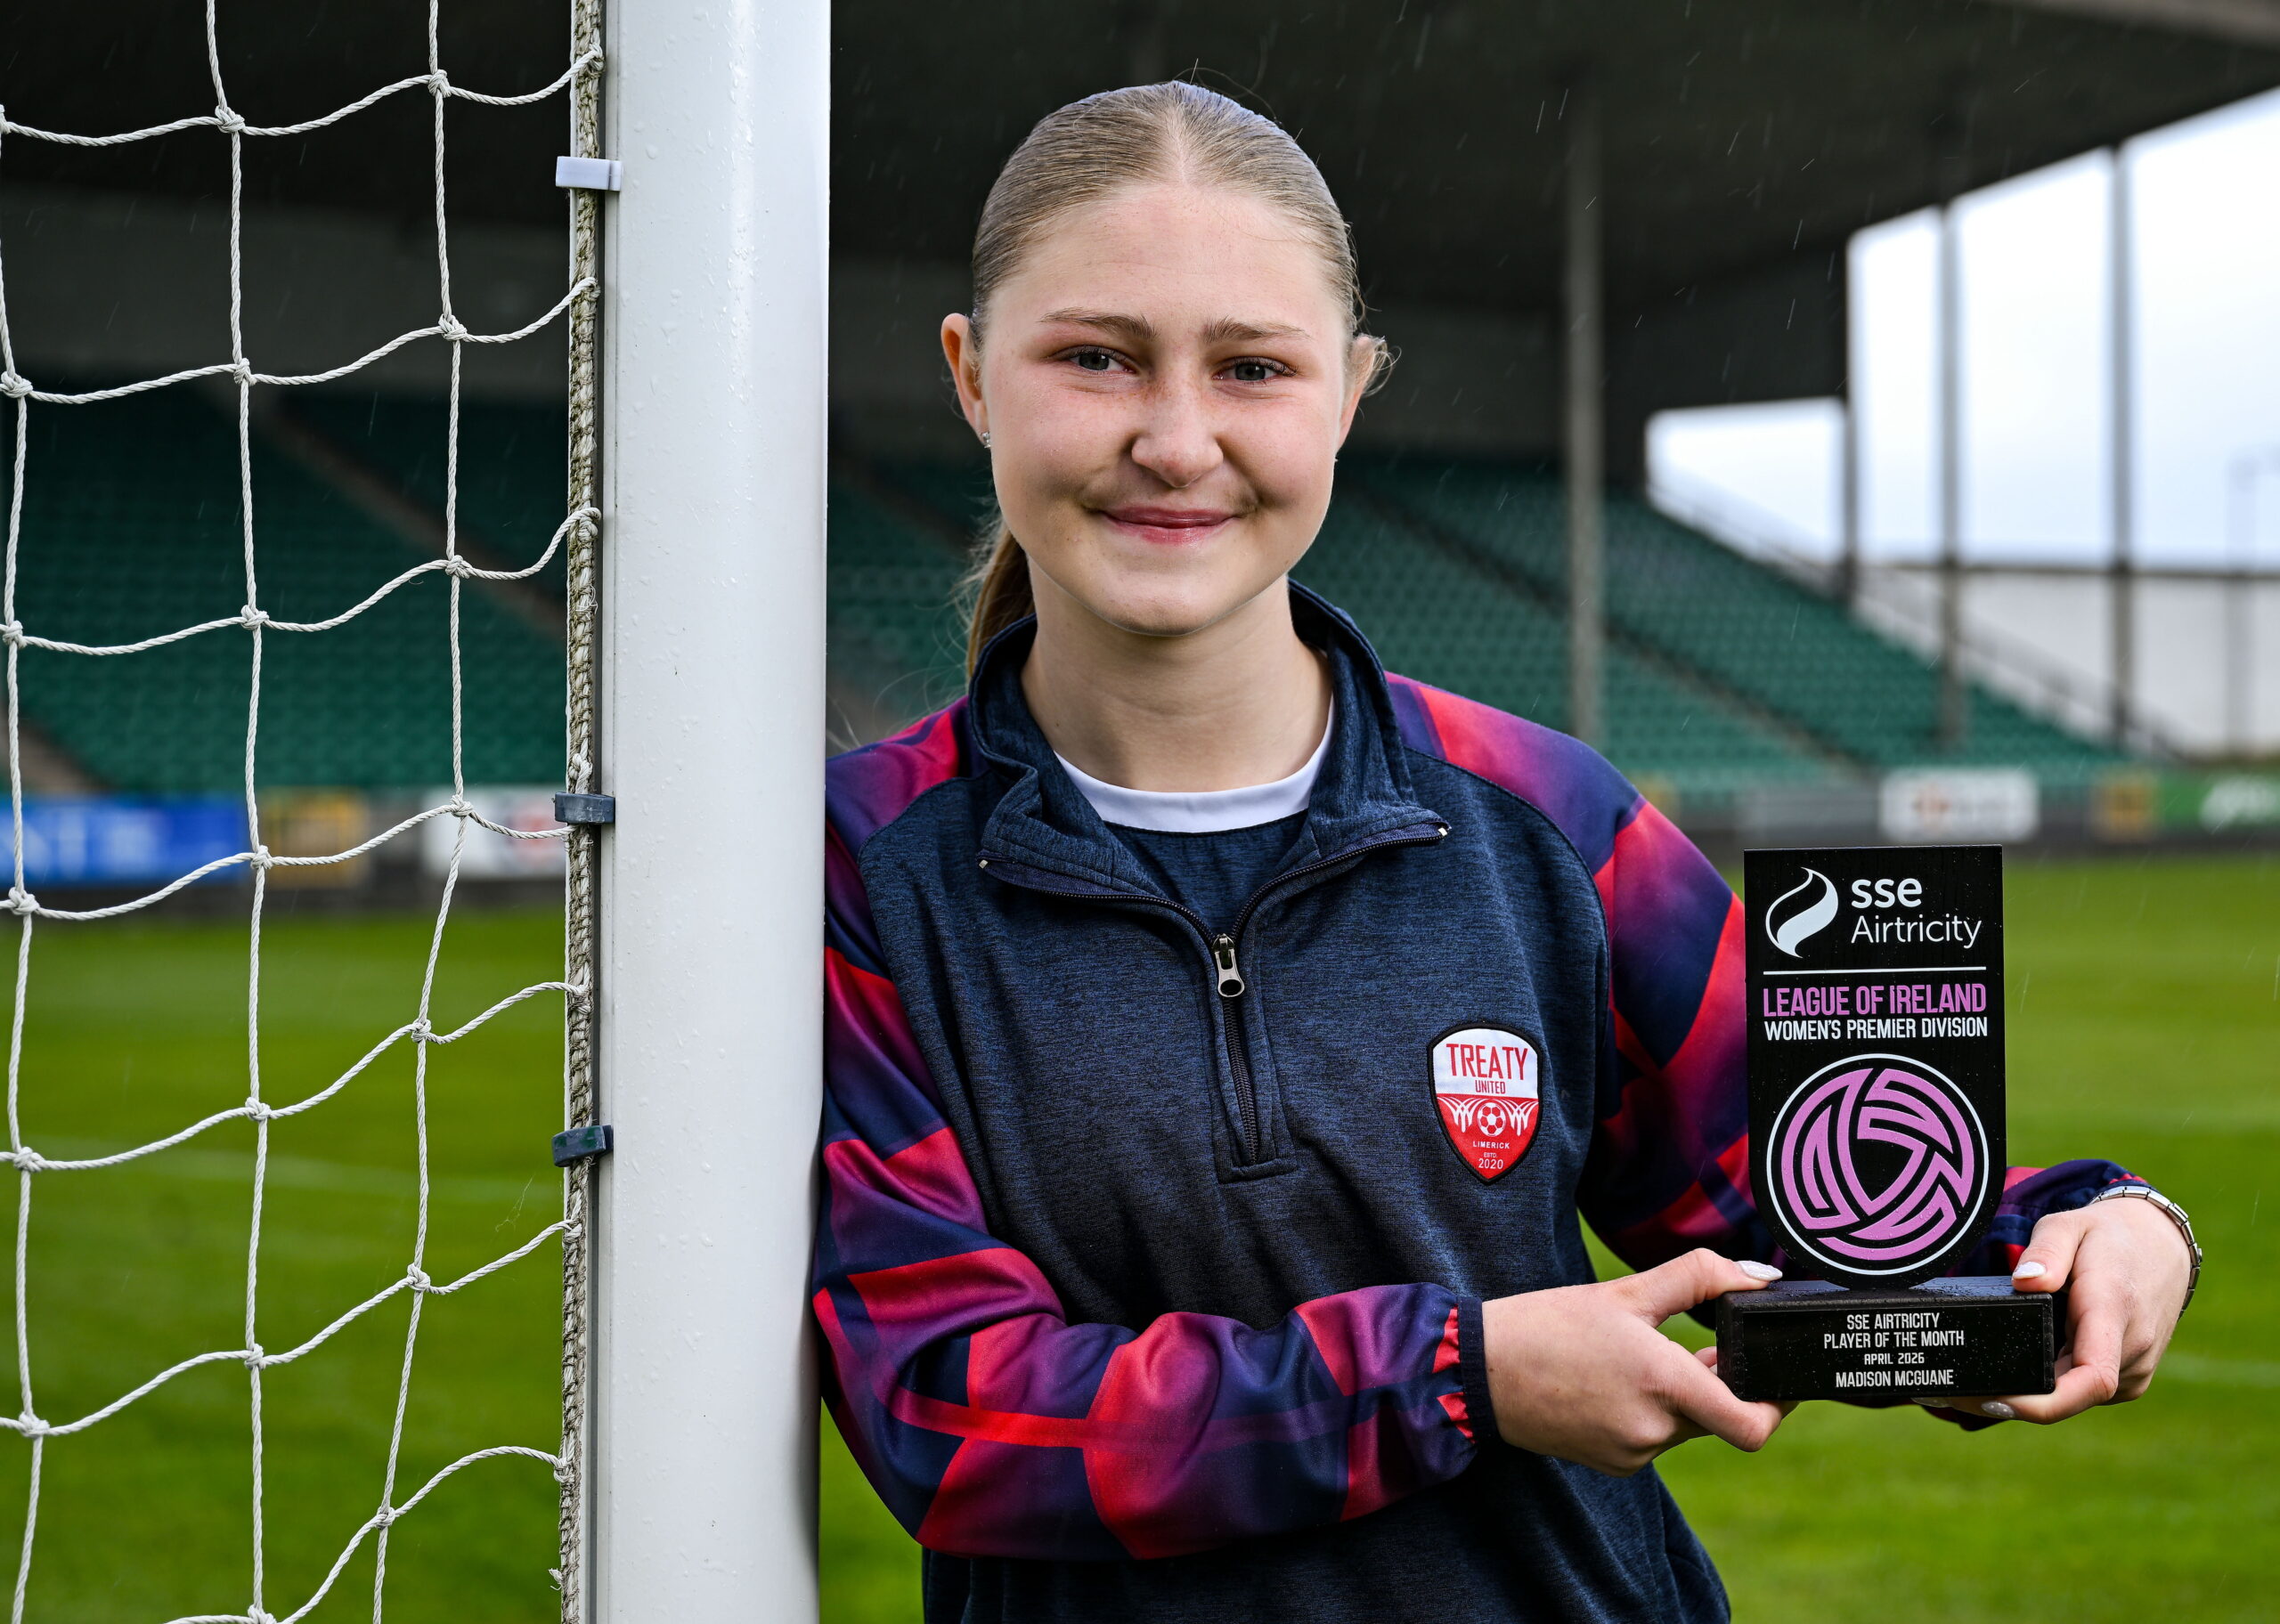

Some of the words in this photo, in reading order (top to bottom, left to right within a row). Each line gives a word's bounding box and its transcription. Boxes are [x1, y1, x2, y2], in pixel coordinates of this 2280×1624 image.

[1851, 878, 1923, 909] sse
[1851, 914, 1983, 949] Airtricity
[1763, 987, 1851, 1017] LEAGUE
[1855, 986, 1885, 1015] OF
[1889, 983, 1987, 1014] IRELAND
[1763, 1019, 1842, 1041] WOMEN'S
[1846, 1019, 1916, 1039] PREMIER
[1921, 1017, 1988, 1038] DIVISION
[1445, 1043, 1528, 1081] TREATY
[1475, 1079, 1506, 1094] UNITED
[1472, 1141, 1510, 1149] LIMERICK
[1478, 1158, 1503, 1169] 2020
[1846, 1314, 1870, 1329] SSE
[1874, 1312, 1940, 1329] AIRTRICITY
[1823, 1332, 1871, 1349] PLAYER
[1875, 1332, 1890, 1347] OF
[1893, 1332, 1918, 1347] THE
[1920, 1330, 1965, 1346] MONTH
[1863, 1353, 1893, 1365] APRIL
[1897, 1352, 1925, 1364] 2026
[1836, 1371, 1892, 1388] MADISON
[1894, 1368, 1954, 1385] MCGUANE
